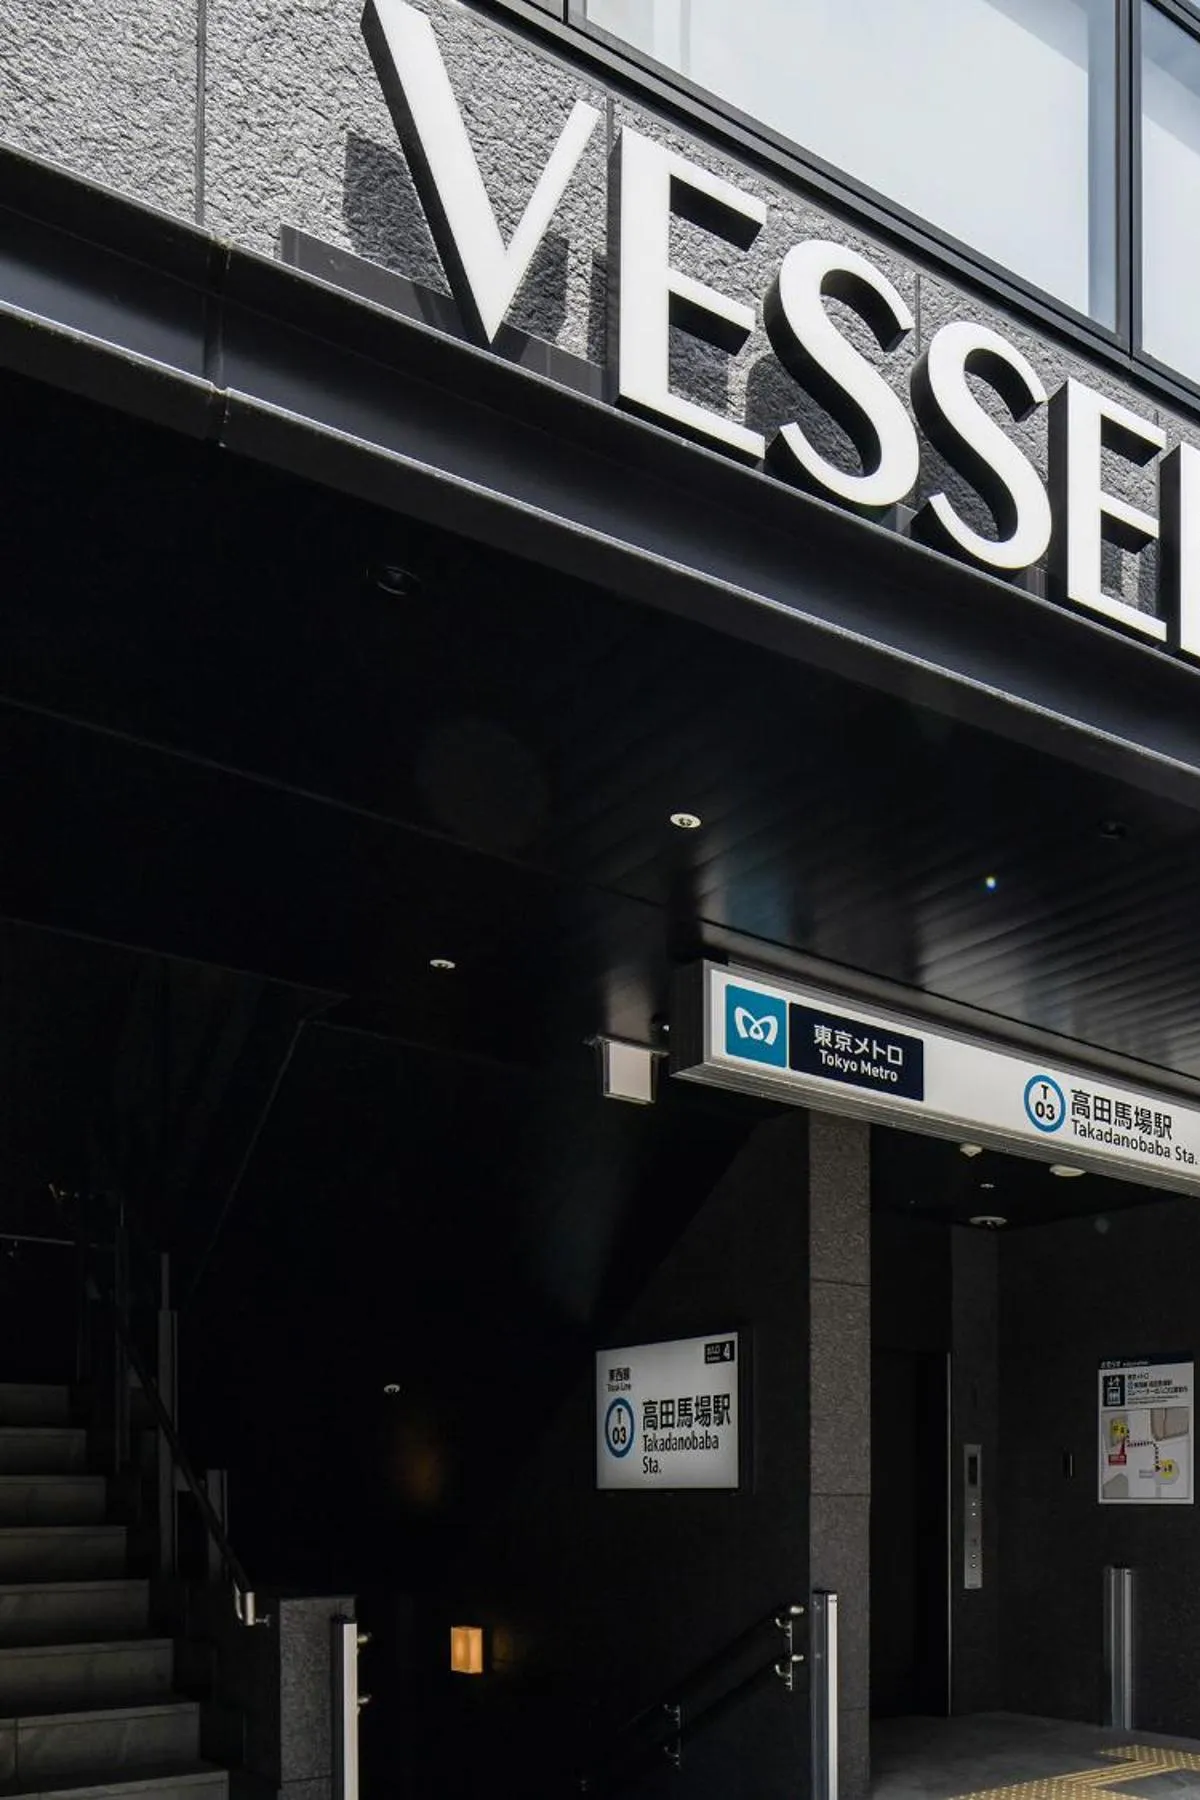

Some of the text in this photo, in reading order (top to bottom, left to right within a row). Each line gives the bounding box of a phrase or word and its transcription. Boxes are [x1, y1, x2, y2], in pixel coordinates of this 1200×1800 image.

[813, 1024, 904, 1066] 東京メトロ
[819, 1049, 898, 1082] Tokyo Metro
[1041, 1084, 1049, 1100] T
[1034, 1101, 1055, 1121] 03
[1071, 1089, 1173, 1141] 高田馬場駅
[1072, 1119, 1198, 1165] Takadanobaba Sta.
[616, 1408, 624, 1424] T
[642, 1394, 731, 1430] 高田馬場駅
[612, 1427, 627, 1445] 03
[642, 1430, 719, 1453] Takadanobaba
[642, 1456, 662, 1475] Sta.
